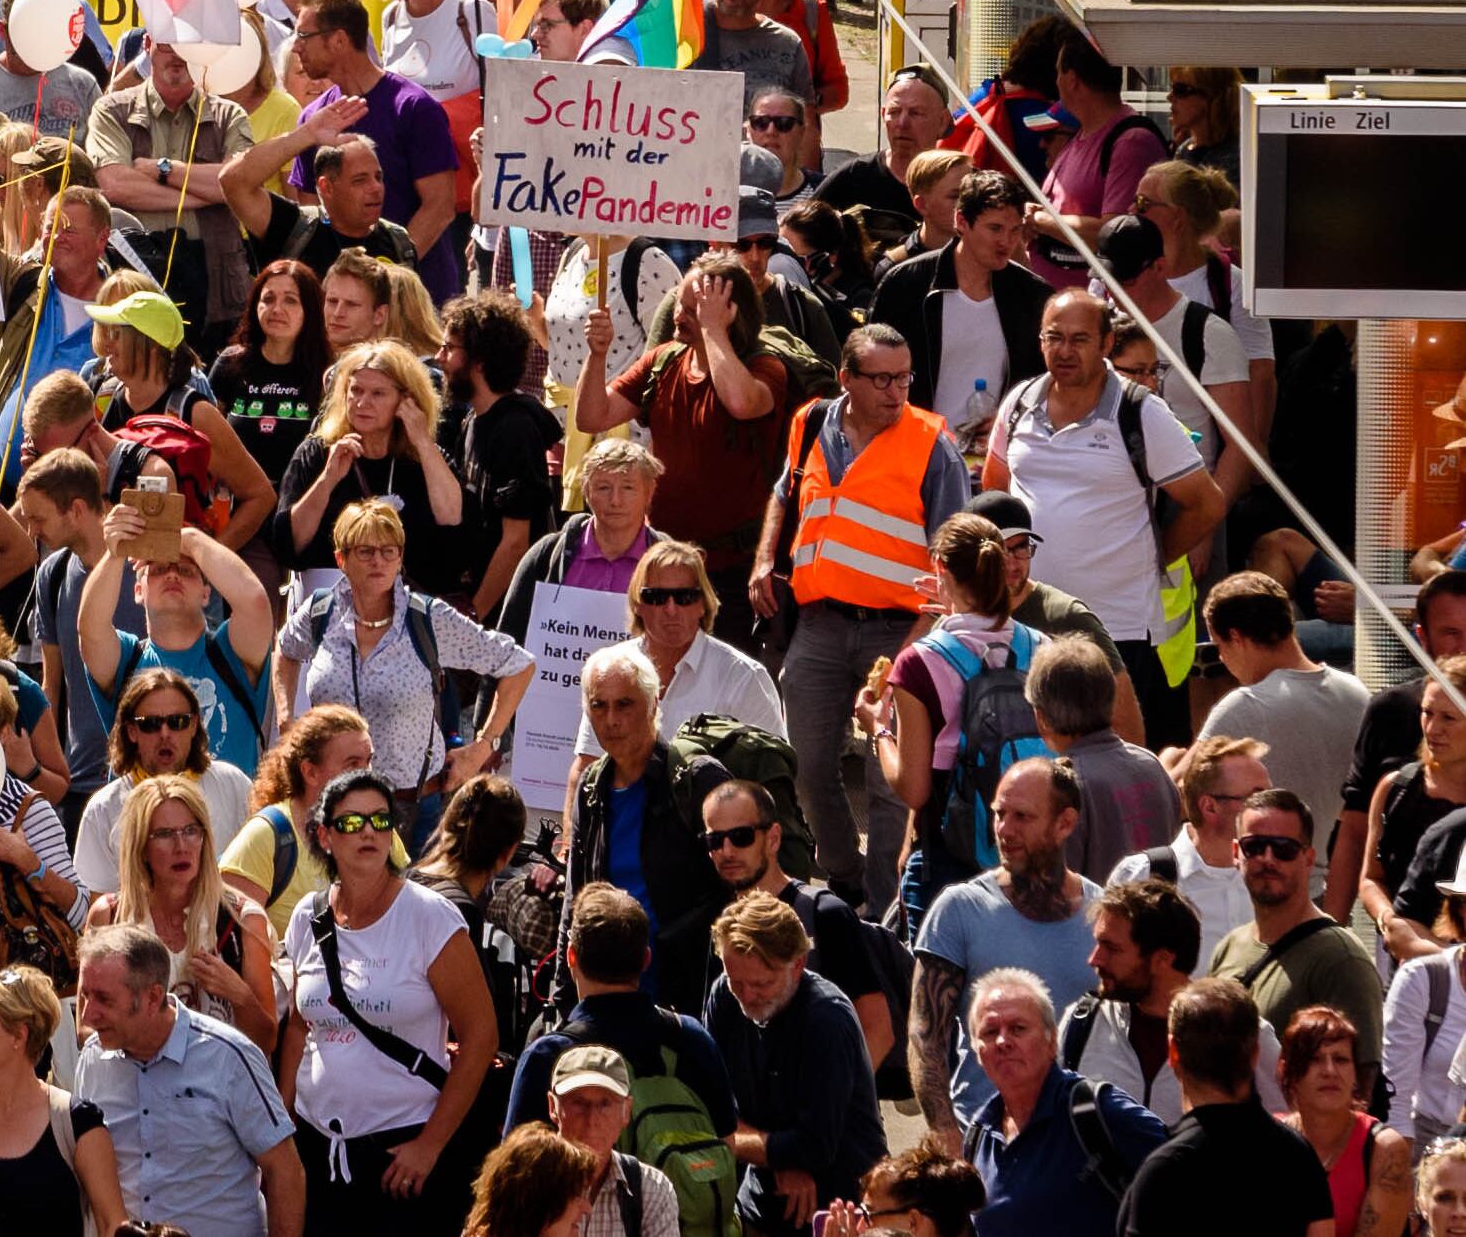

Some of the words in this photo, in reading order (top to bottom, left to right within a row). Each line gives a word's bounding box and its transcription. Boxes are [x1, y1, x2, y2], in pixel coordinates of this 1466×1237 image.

[525, 75, 700, 145] Schluss
[1290, 111, 1336, 129] Linie
[1355, 111, 1390, 130] Ziel
[574, 136, 615, 160] mit
[626, 140, 670, 165] der
[583, 624, 632, 642] Mens
[544, 642, 568, 660] hat
[572, 646, 589, 662] da
[540, 669, 558, 683] zu
